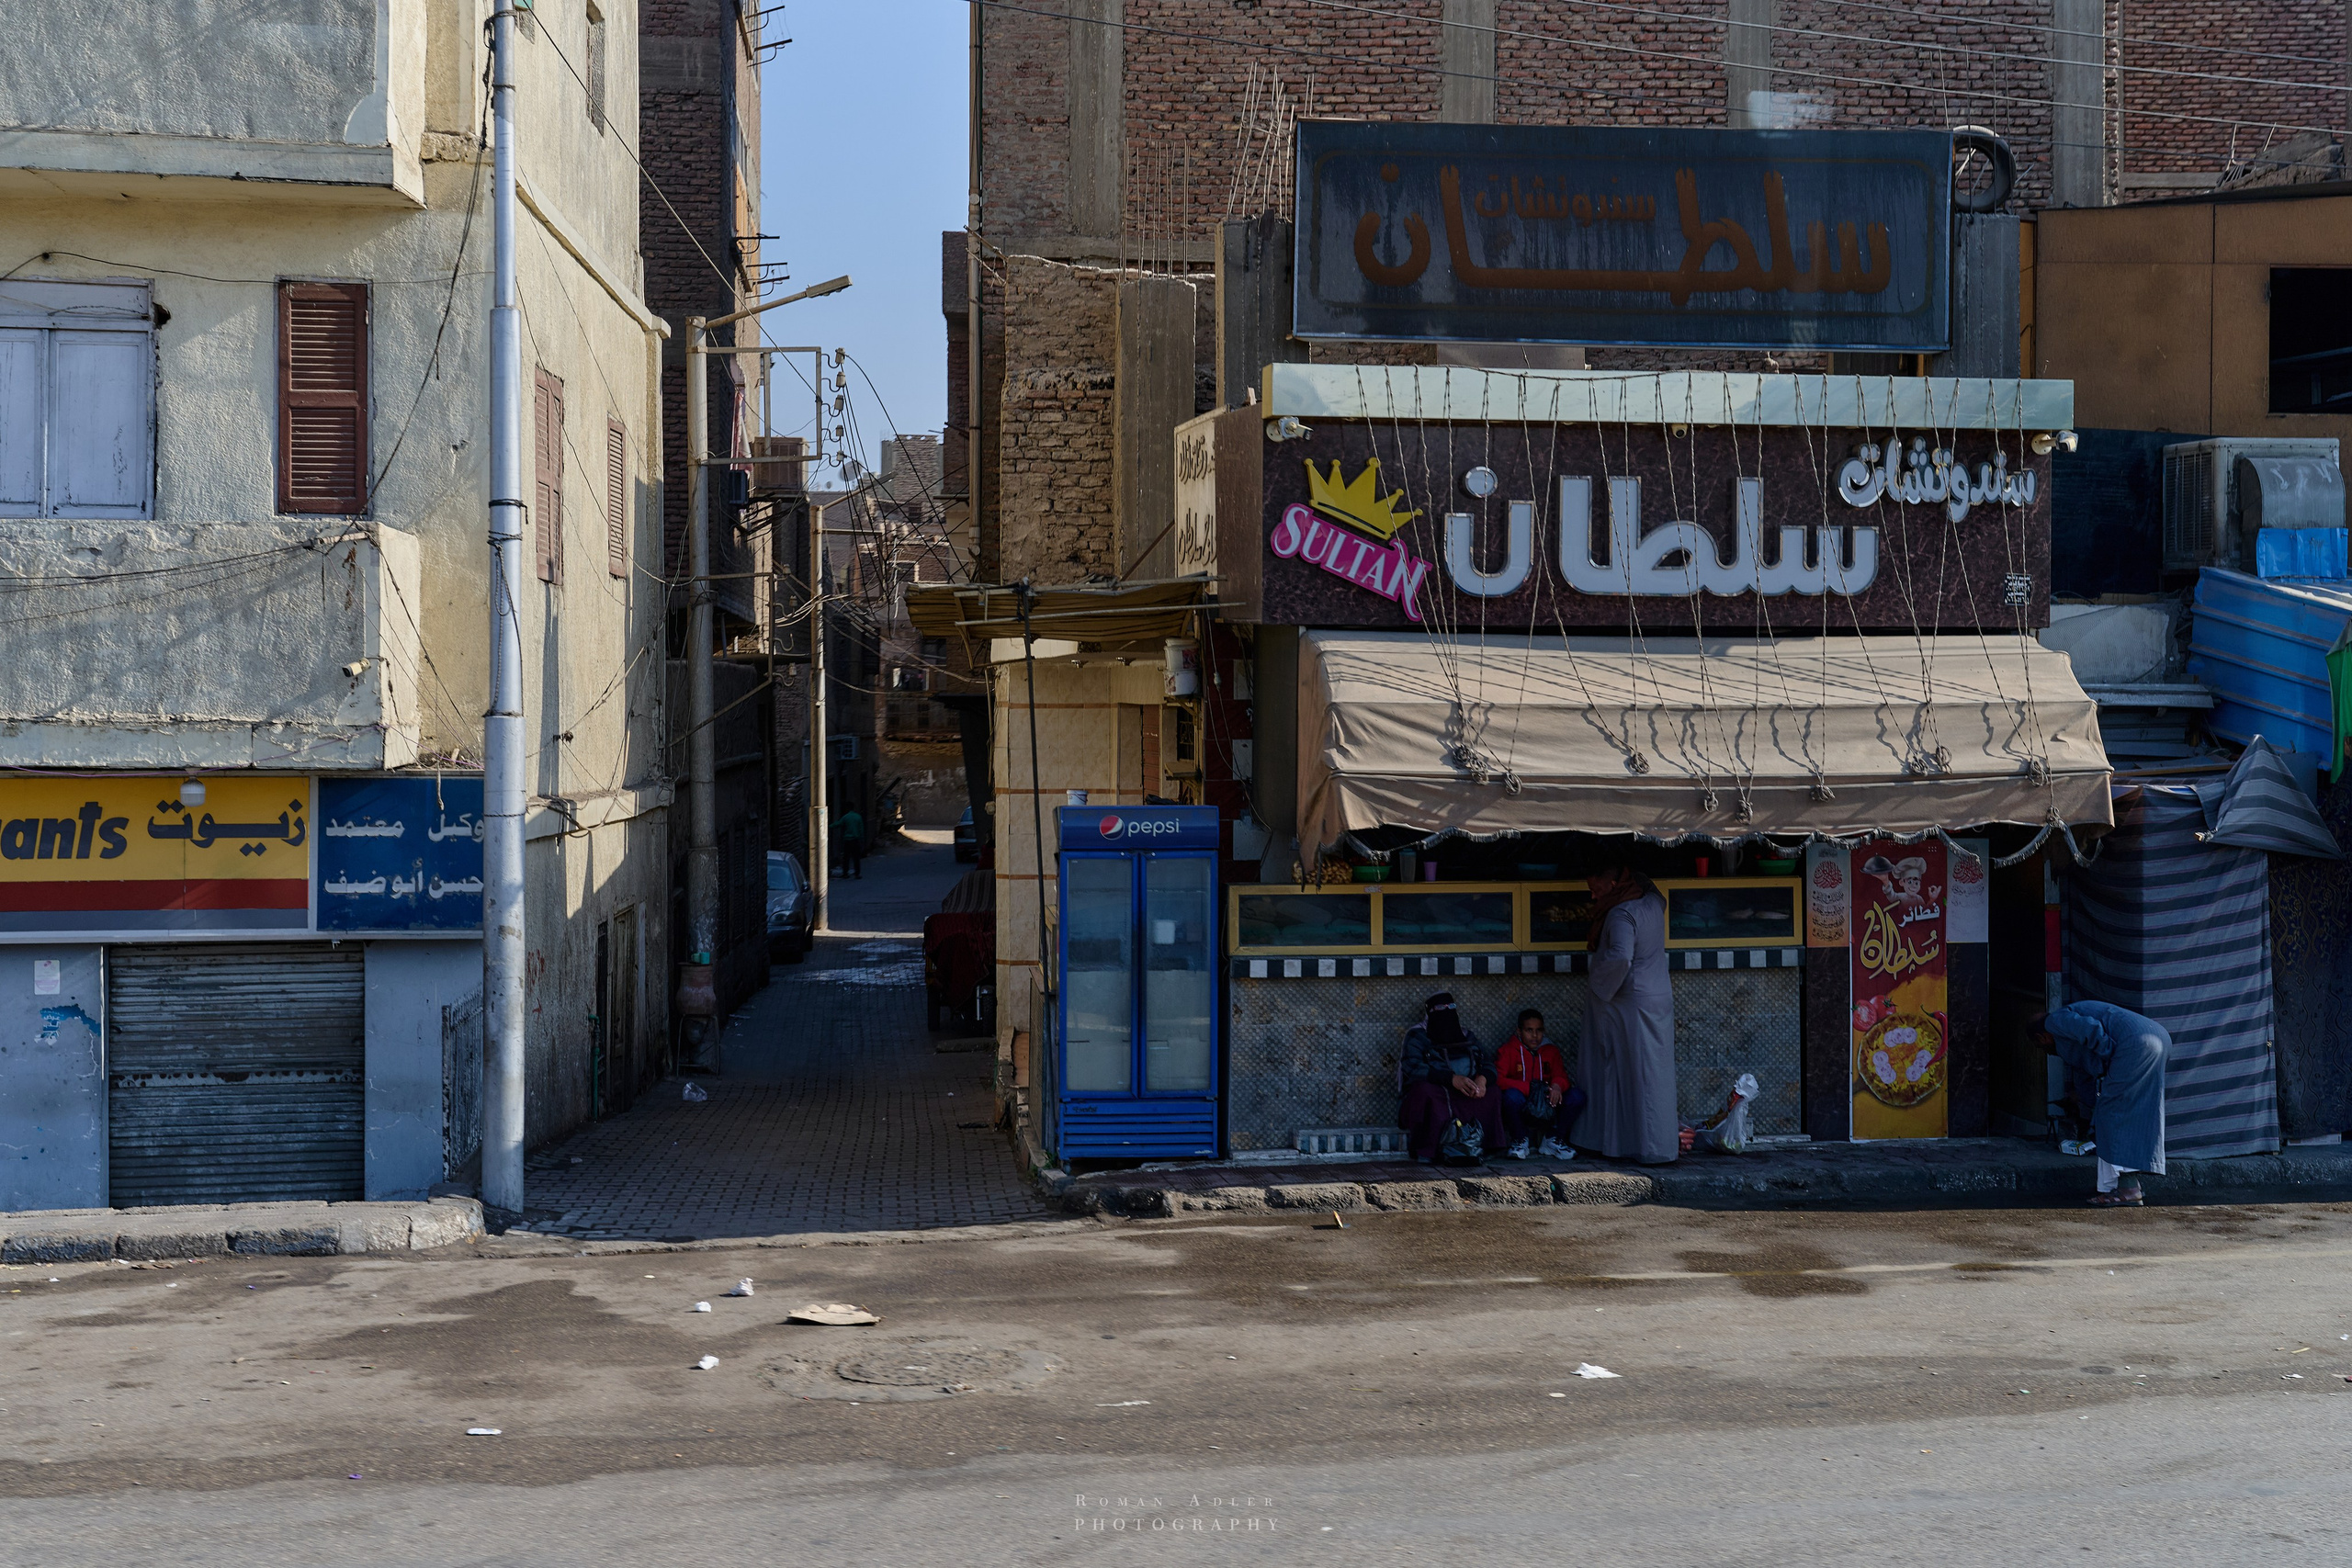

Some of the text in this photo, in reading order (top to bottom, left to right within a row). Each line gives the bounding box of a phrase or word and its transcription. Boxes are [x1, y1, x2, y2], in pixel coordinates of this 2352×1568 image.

[1352, 163, 1892, 307] سلطان
[1838, 436, 2037, 523] سندوتشات
[1444, 466, 1880, 598] سلطان
[1273, 506, 1428, 618] SULTAN
[147, 798, 307, 857] زيوت
[326, 813, 484, 842] وكيل معتمد
[1127, 818, 1181, 837] pepsi
[324, 869, 387, 899] ضيف
[428, 875, 484, 899] حسن
[1898, 902, 1940, 928] فطائر
